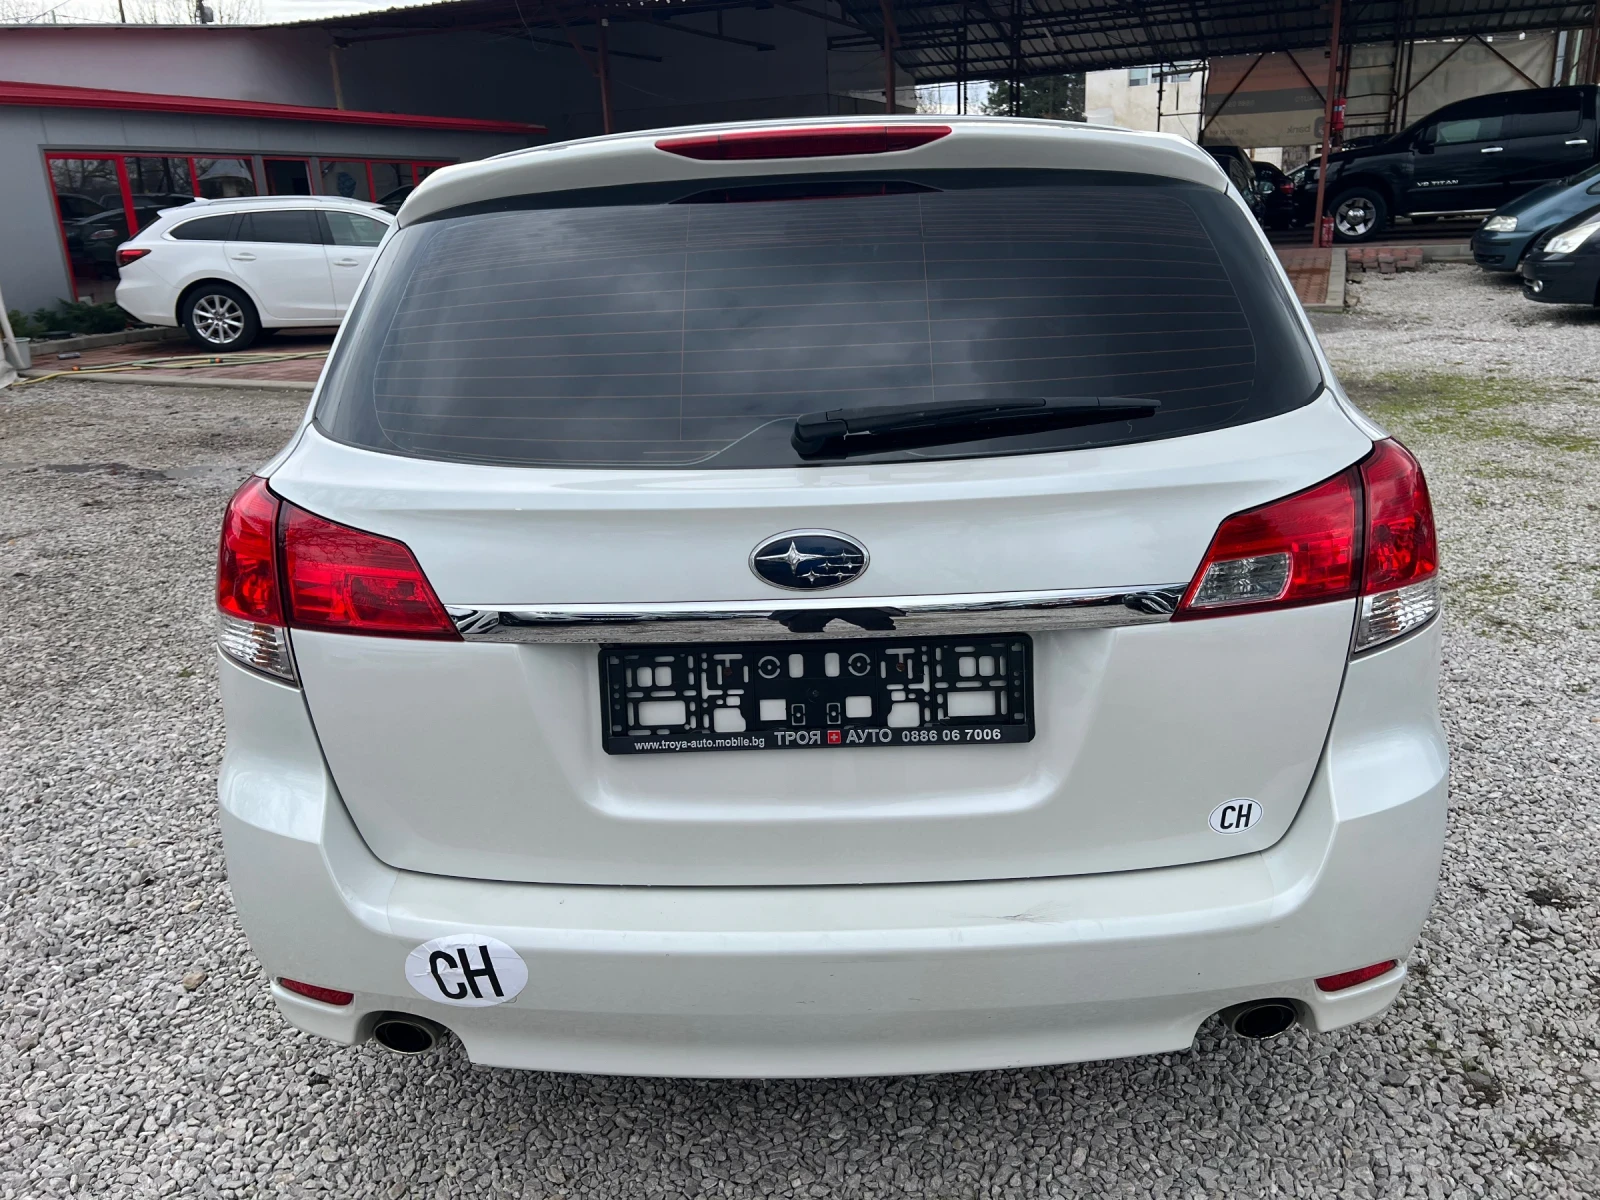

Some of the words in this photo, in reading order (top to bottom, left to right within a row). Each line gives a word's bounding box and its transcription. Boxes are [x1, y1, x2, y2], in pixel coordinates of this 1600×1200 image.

[634, 737, 765, 751] www.troya-auto.mobile.bg
[774, 730, 821, 746] ТРОЯ
[846, 728, 893, 743] АУТО
[901, 730, 938, 742] 0886
[942, 729, 961, 741] 06
[964, 728, 1002, 741] 7006
[1220, 803, 1253, 830] CH
[429, 945, 505, 1000] CH
